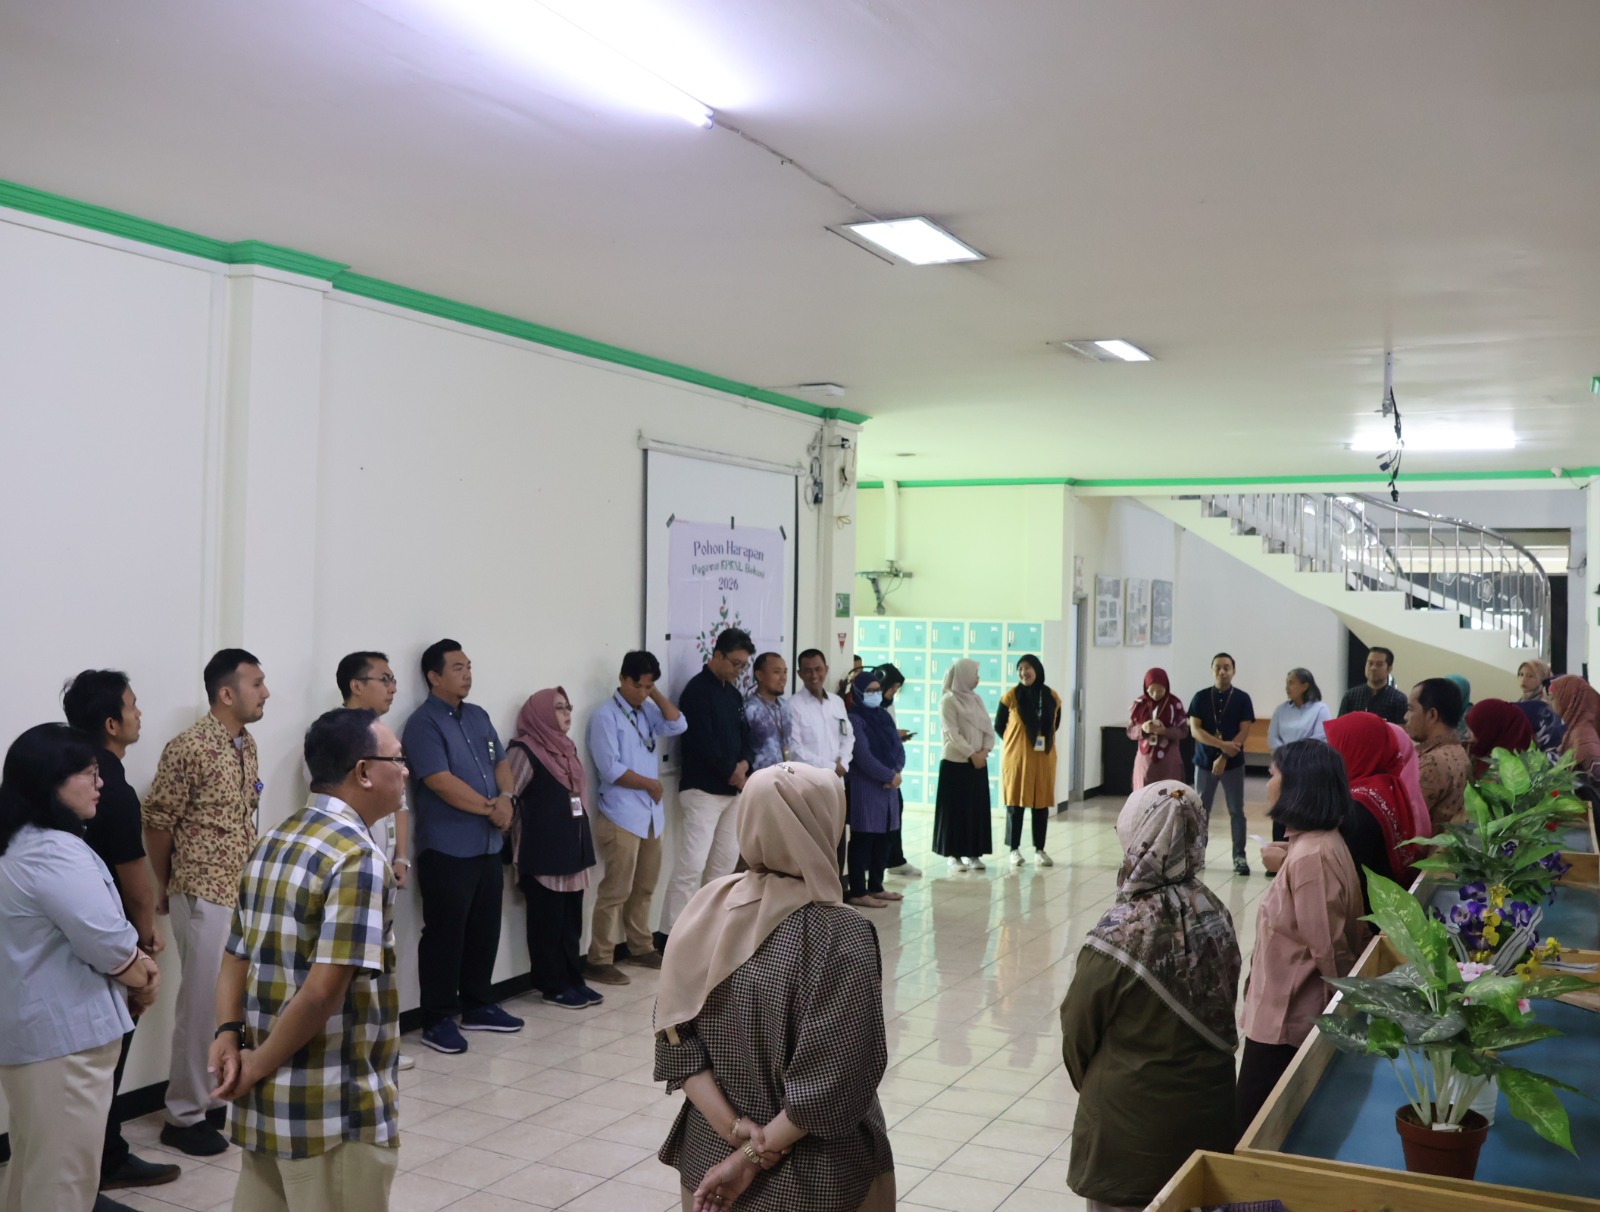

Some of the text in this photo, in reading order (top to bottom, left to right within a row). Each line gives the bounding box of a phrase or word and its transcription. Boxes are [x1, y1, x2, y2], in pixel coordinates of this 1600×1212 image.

[693, 540, 764, 562] Pohon Harapan
[718, 577, 739, 591] 2026
